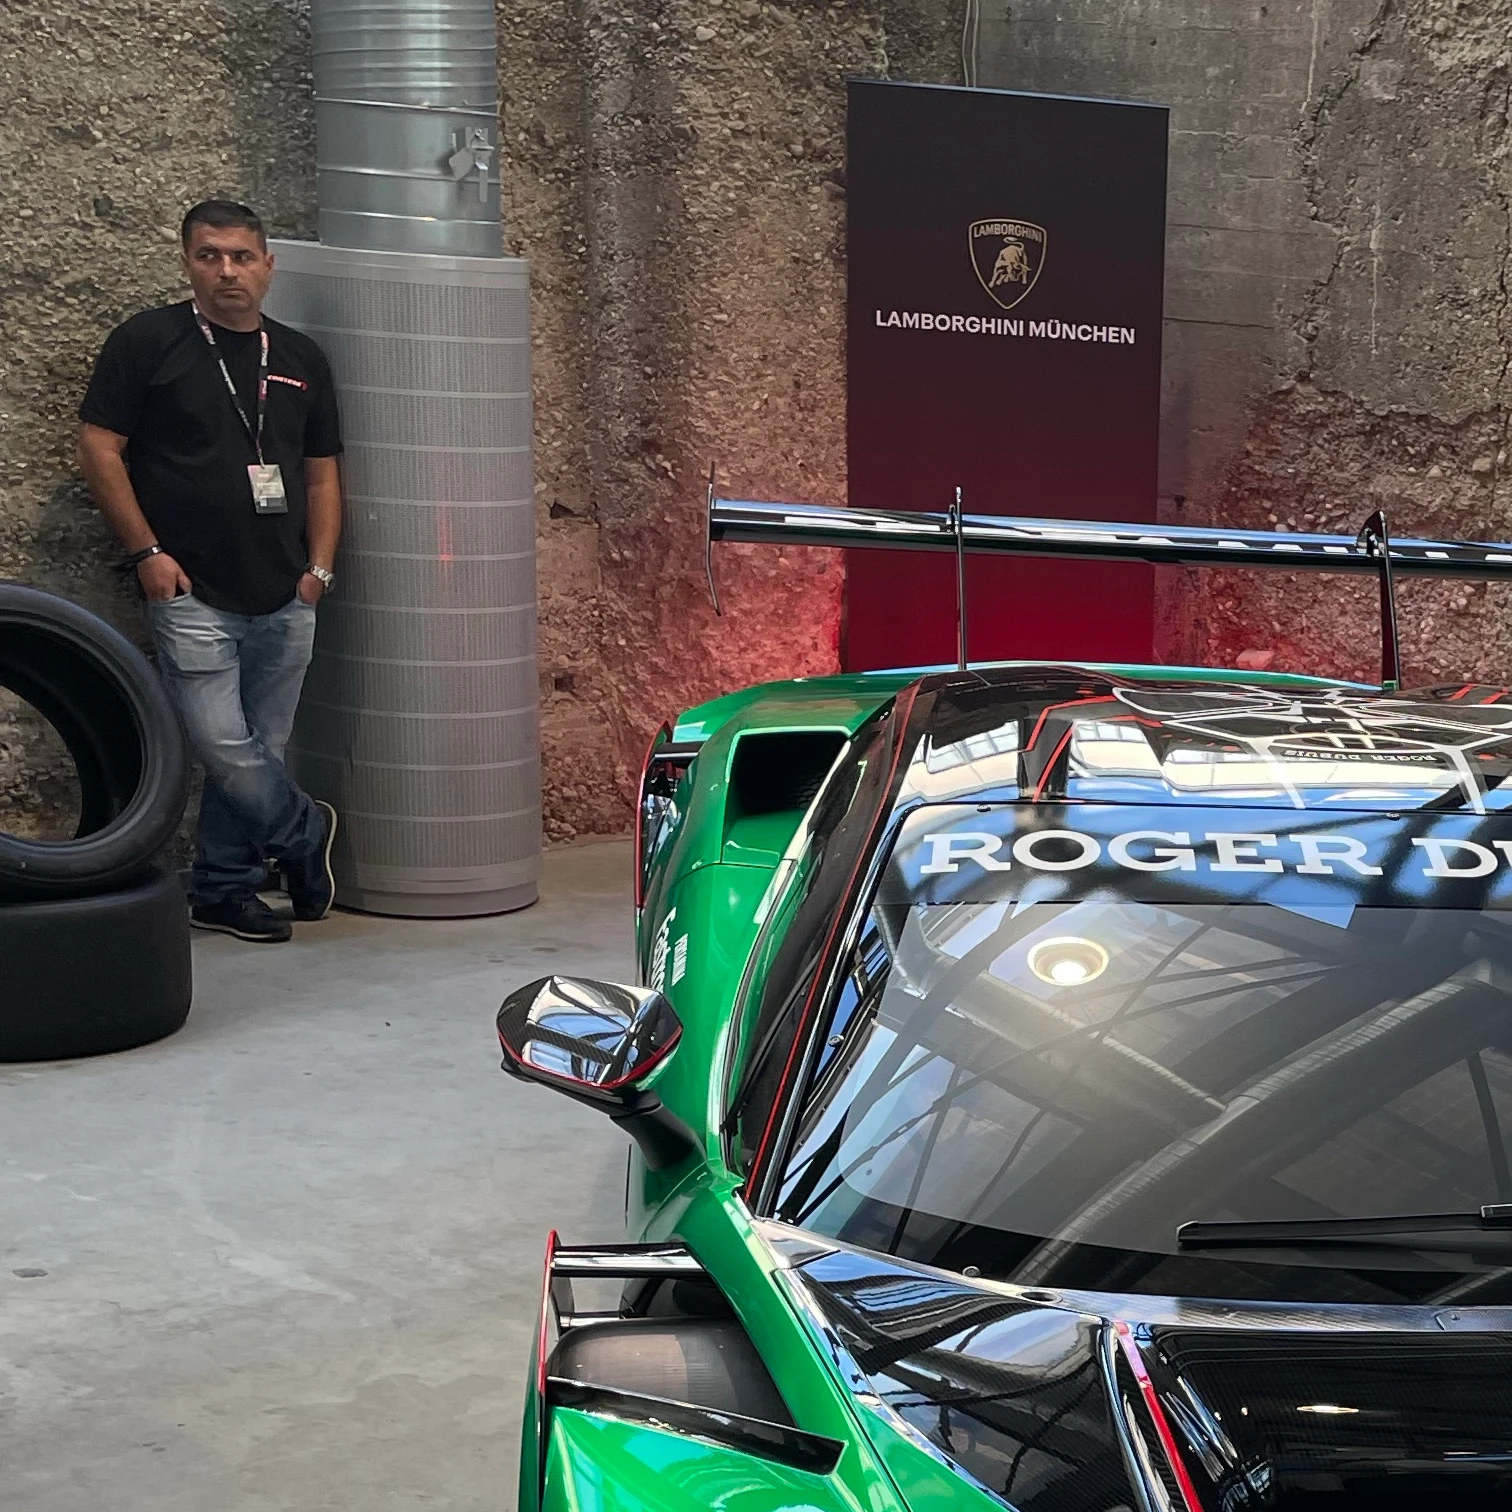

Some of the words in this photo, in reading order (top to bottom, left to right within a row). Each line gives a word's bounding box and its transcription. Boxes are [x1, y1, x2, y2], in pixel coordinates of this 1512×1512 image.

[973, 223, 1042, 243] LAMBORGHINI
[875, 309, 1024, 337] LAMBORGHINI
[1028, 319, 1136, 345] MÜNCHEN
[919, 829, 1382, 877] ROGER
